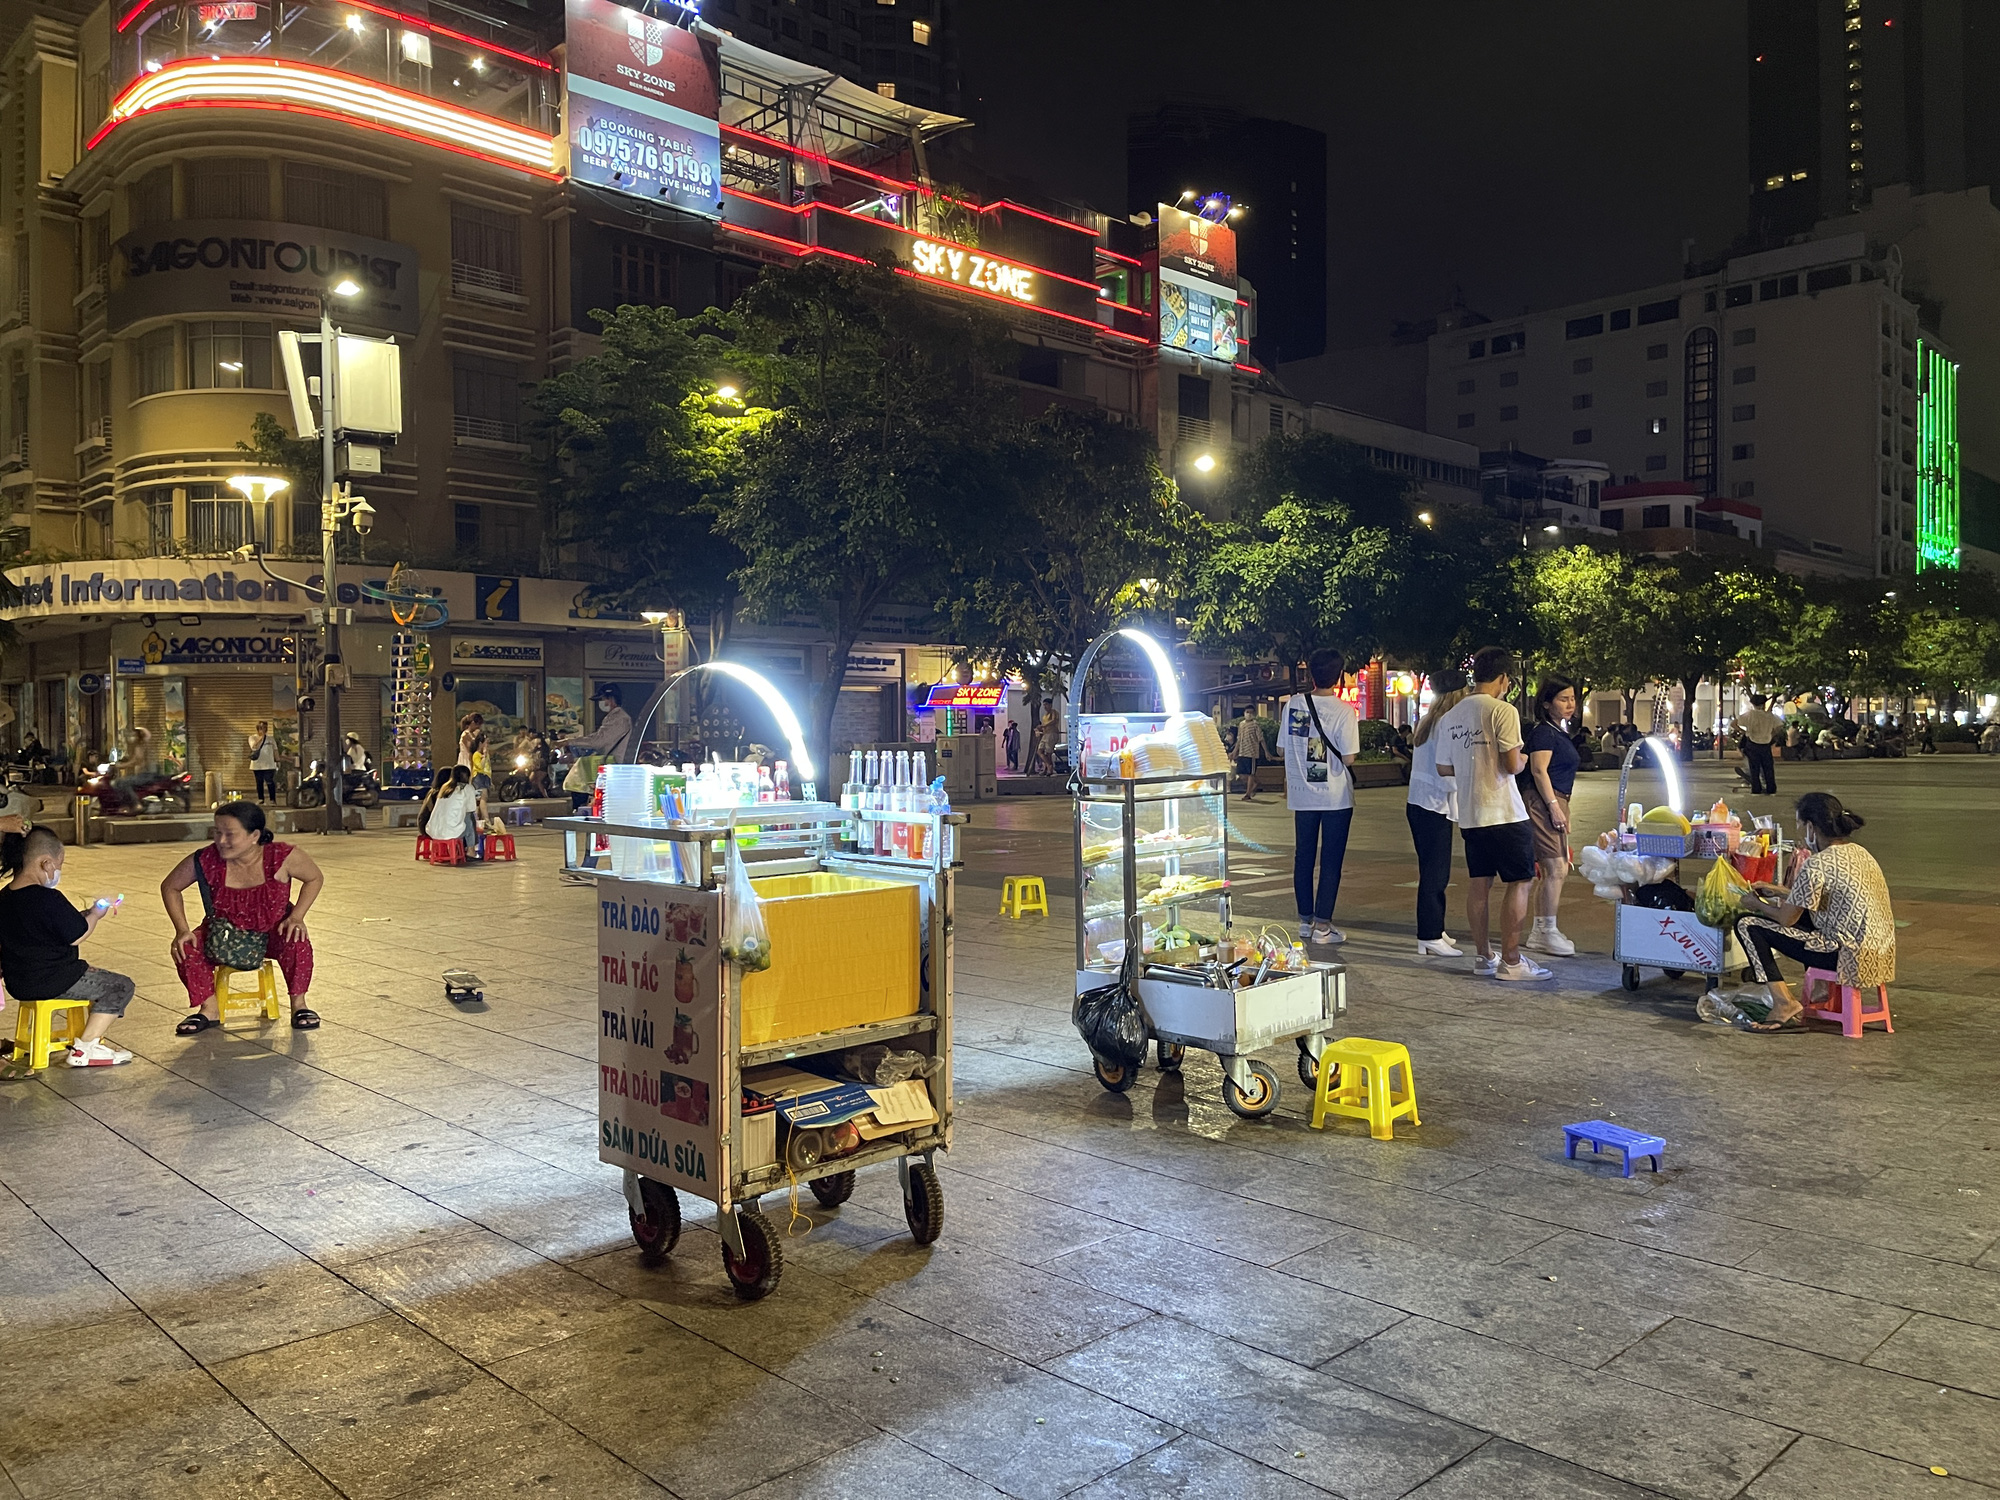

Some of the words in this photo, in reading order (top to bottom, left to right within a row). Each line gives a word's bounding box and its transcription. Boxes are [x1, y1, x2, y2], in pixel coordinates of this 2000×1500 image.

[616, 63, 642, 80] SKY
[643, 73, 676, 93] ZONE
[600, 118, 655, 143] BOOKING
[658, 136, 694, 156] TABLE
[582, 154, 608, 169] BEER
[610, 163, 650, 180] GARDEN
[659, 175, 680, 189] LIVE
[682, 182, 711, 198] MUSIC
[130, 237, 401, 290] SAIGONTOURIST
[912, 240, 963, 280] SKY
[969, 255, 1033, 301] ZONE
[61, 571, 289, 606] Information
[957, 687, 977, 697] SKY
[977, 688, 1001, 698] ZONE
[602, 896, 627, 930] TRÀ
[632, 898, 659, 935] ĐÀO
[602, 951, 628, 986] TRÀ
[632, 951, 659, 993] TẮC
[602, 1006, 627, 1042] TRÀ
[632, 1009, 653, 1048] VẢI
[601, 1062, 628, 1097] TRÀ
[632, 1070, 658, 1107] DÂU
[603, 1116, 634, 1155] SÂM
[639, 1128, 669, 1168] DỨA
[675, 1140, 706, 1182] SỮA
